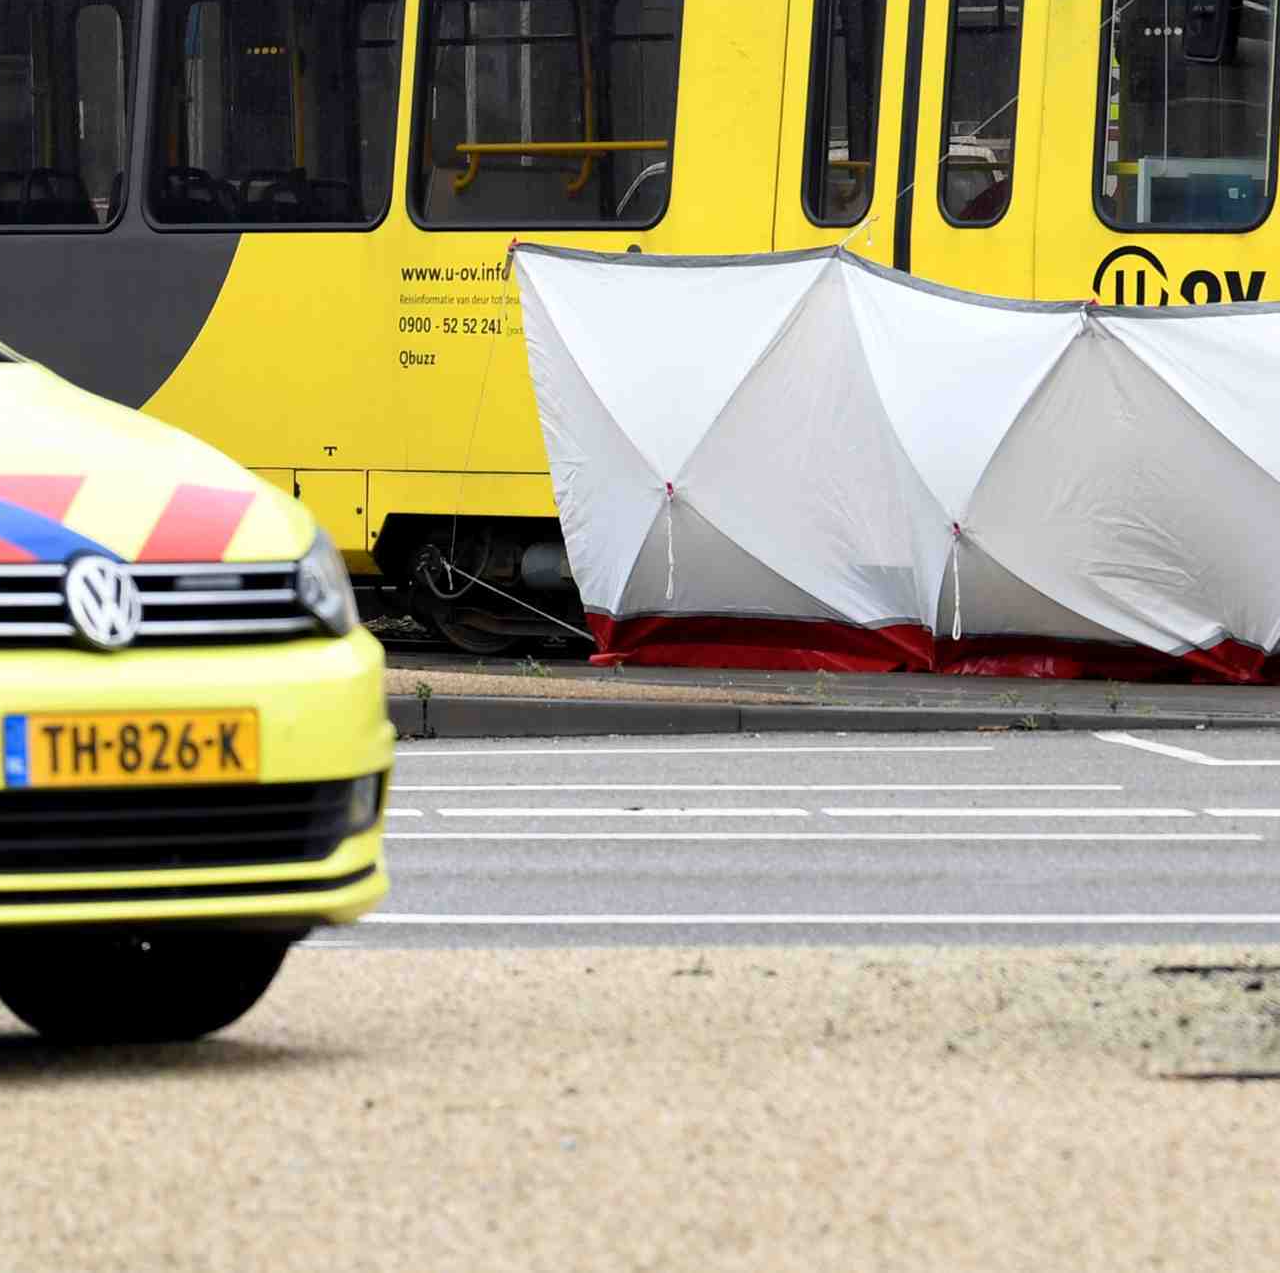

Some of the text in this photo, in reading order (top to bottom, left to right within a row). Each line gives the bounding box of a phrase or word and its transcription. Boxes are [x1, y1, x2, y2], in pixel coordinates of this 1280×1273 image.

[399, 316, 432, 333] 0900
[442, 317, 458, 334] 52
[462, 317, 478, 334] 52
[481, 318, 502, 334] 241
[400, 350, 436, 368] Qbuzz
[42, 723, 243, 774] TH-826-K
